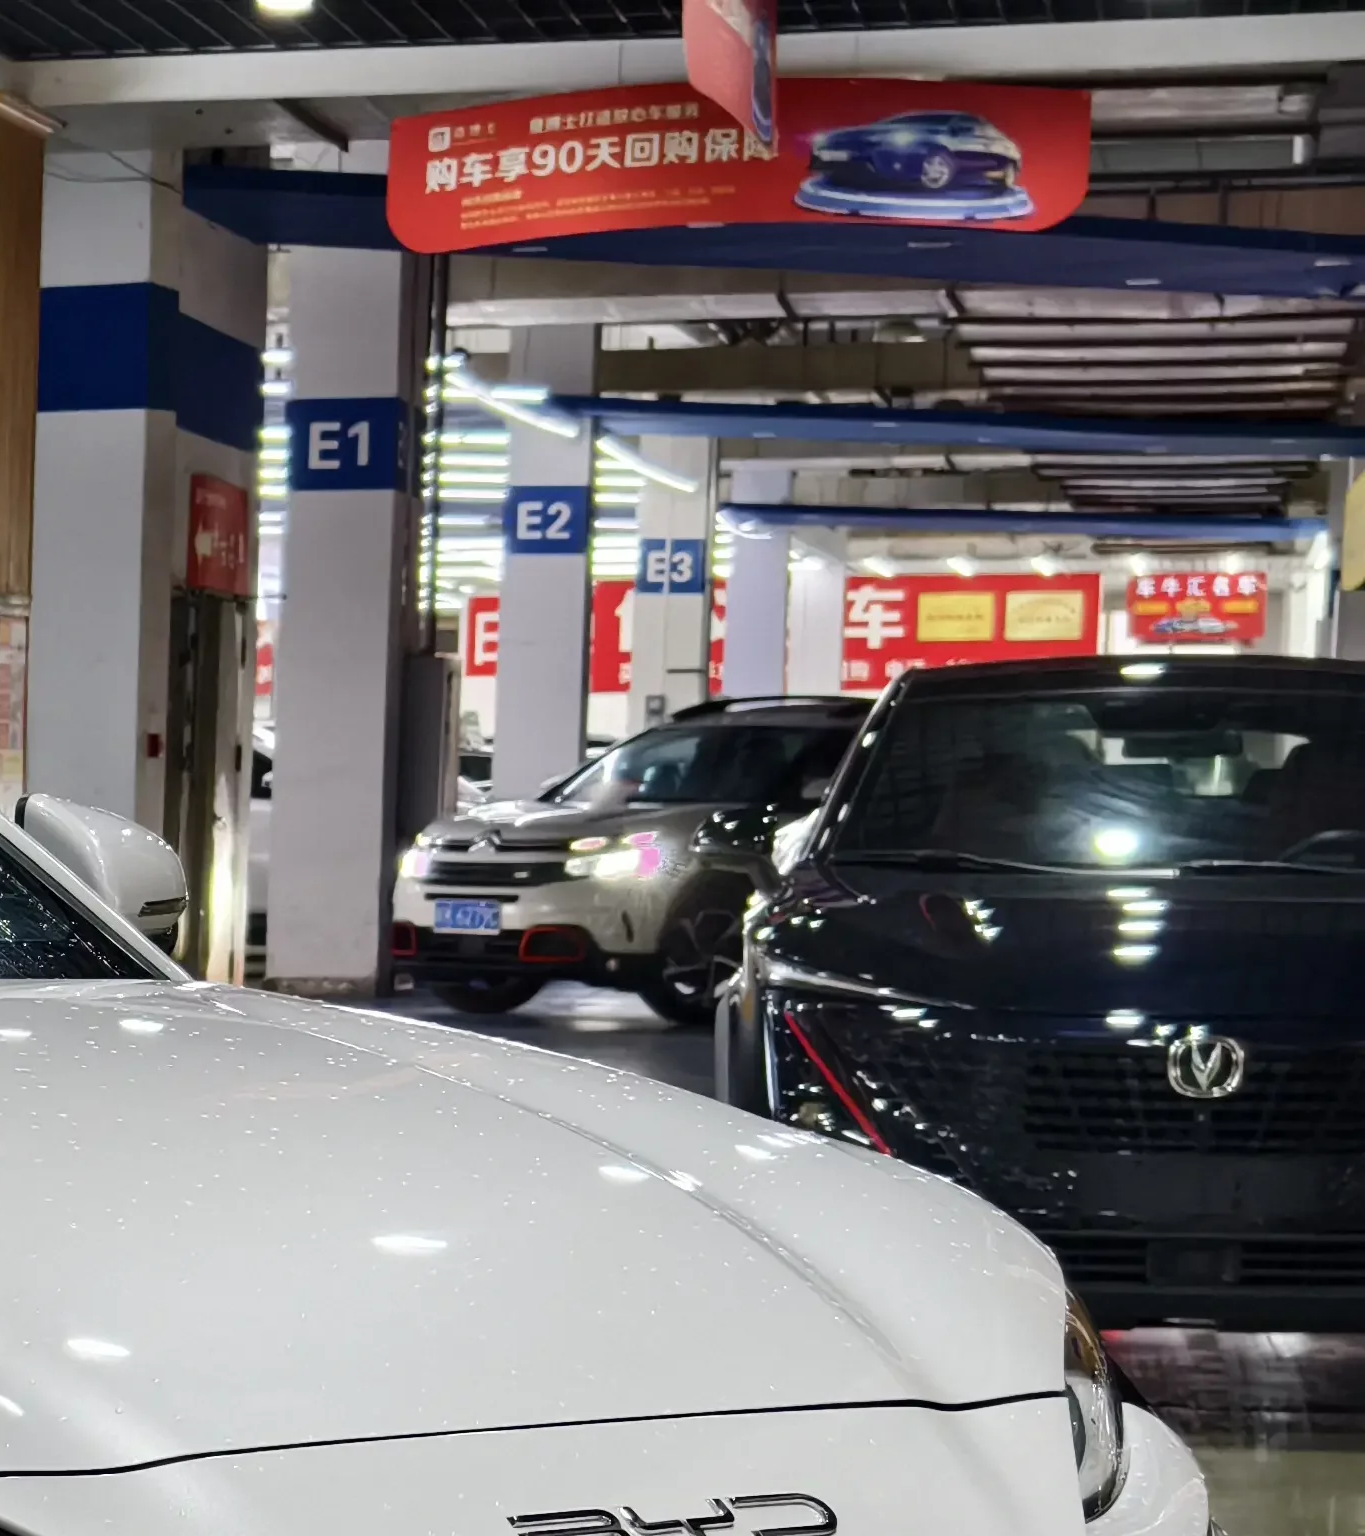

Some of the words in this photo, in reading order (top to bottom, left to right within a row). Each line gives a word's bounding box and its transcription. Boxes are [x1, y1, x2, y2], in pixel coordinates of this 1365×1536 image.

[307, 420, 371, 471] E1
[516, 501, 572, 541] E2
[644, 549, 693, 585] E3
